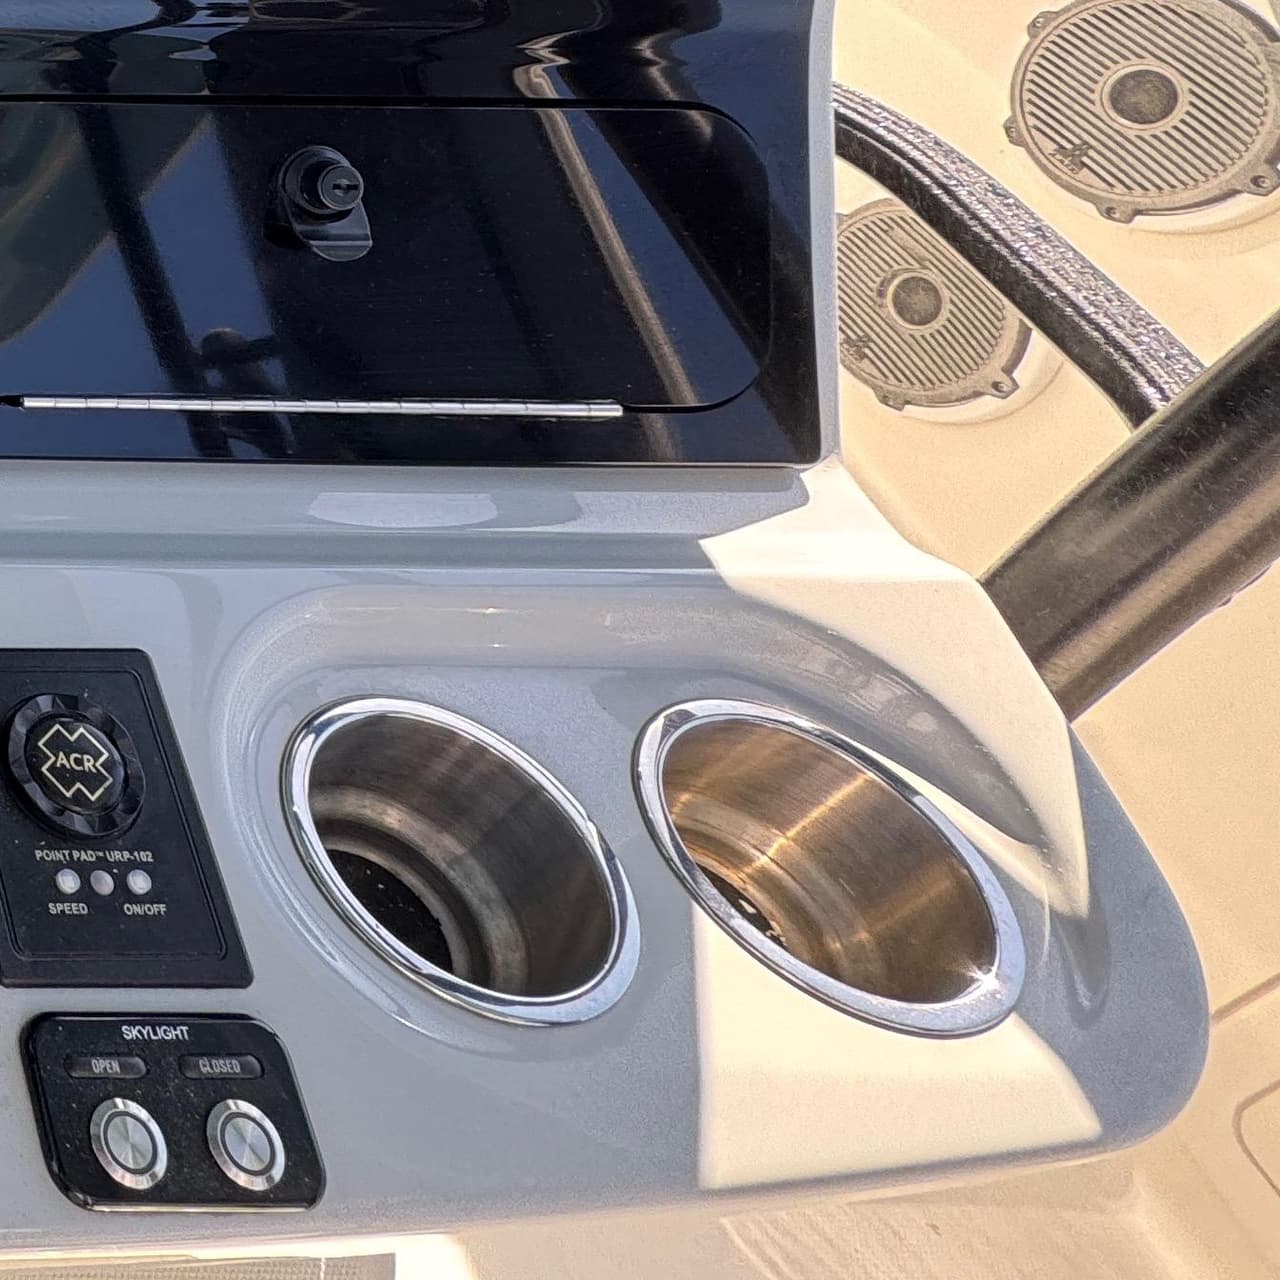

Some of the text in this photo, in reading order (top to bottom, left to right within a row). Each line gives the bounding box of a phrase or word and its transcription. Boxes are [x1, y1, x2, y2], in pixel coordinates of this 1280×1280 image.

[55, 751, 97, 773] ACR
[35, 850, 154, 863] POINT URP-102
[48, 902, 88, 915] SPEED
[123, 903, 167, 916] ON/OFF
[121, 1025, 189, 1041] SKYLIGHT
[91, 1059, 120, 1074] OPEN
[199, 1058, 240, 1073] CLOSED
